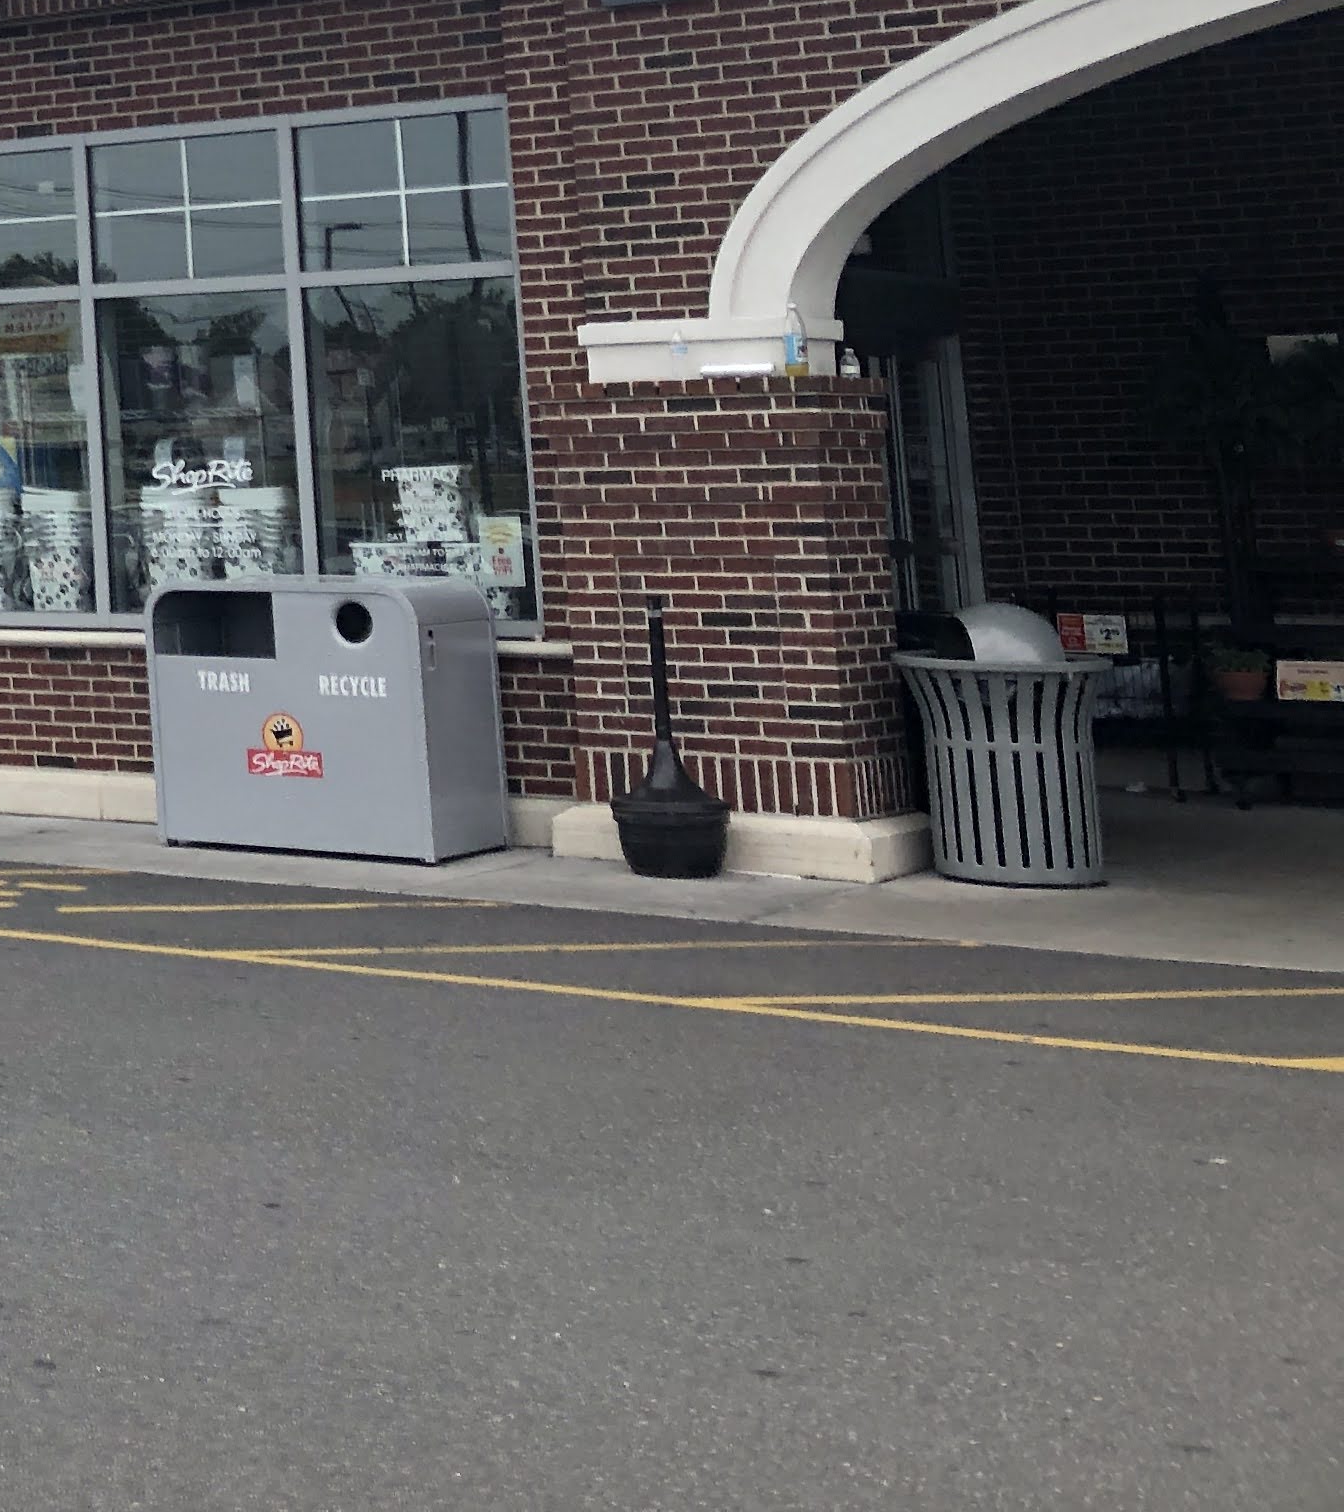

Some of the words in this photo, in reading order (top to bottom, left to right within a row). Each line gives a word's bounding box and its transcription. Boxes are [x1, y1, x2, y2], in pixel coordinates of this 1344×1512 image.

[151, 457, 254, 495] ShopRite
[381, 468, 459, 482] PHARMACY
[197, 670, 250, 694] TRASH
[318, 673, 388, 699] RECYCLE
[251, 752, 322, 777] ShopRite
